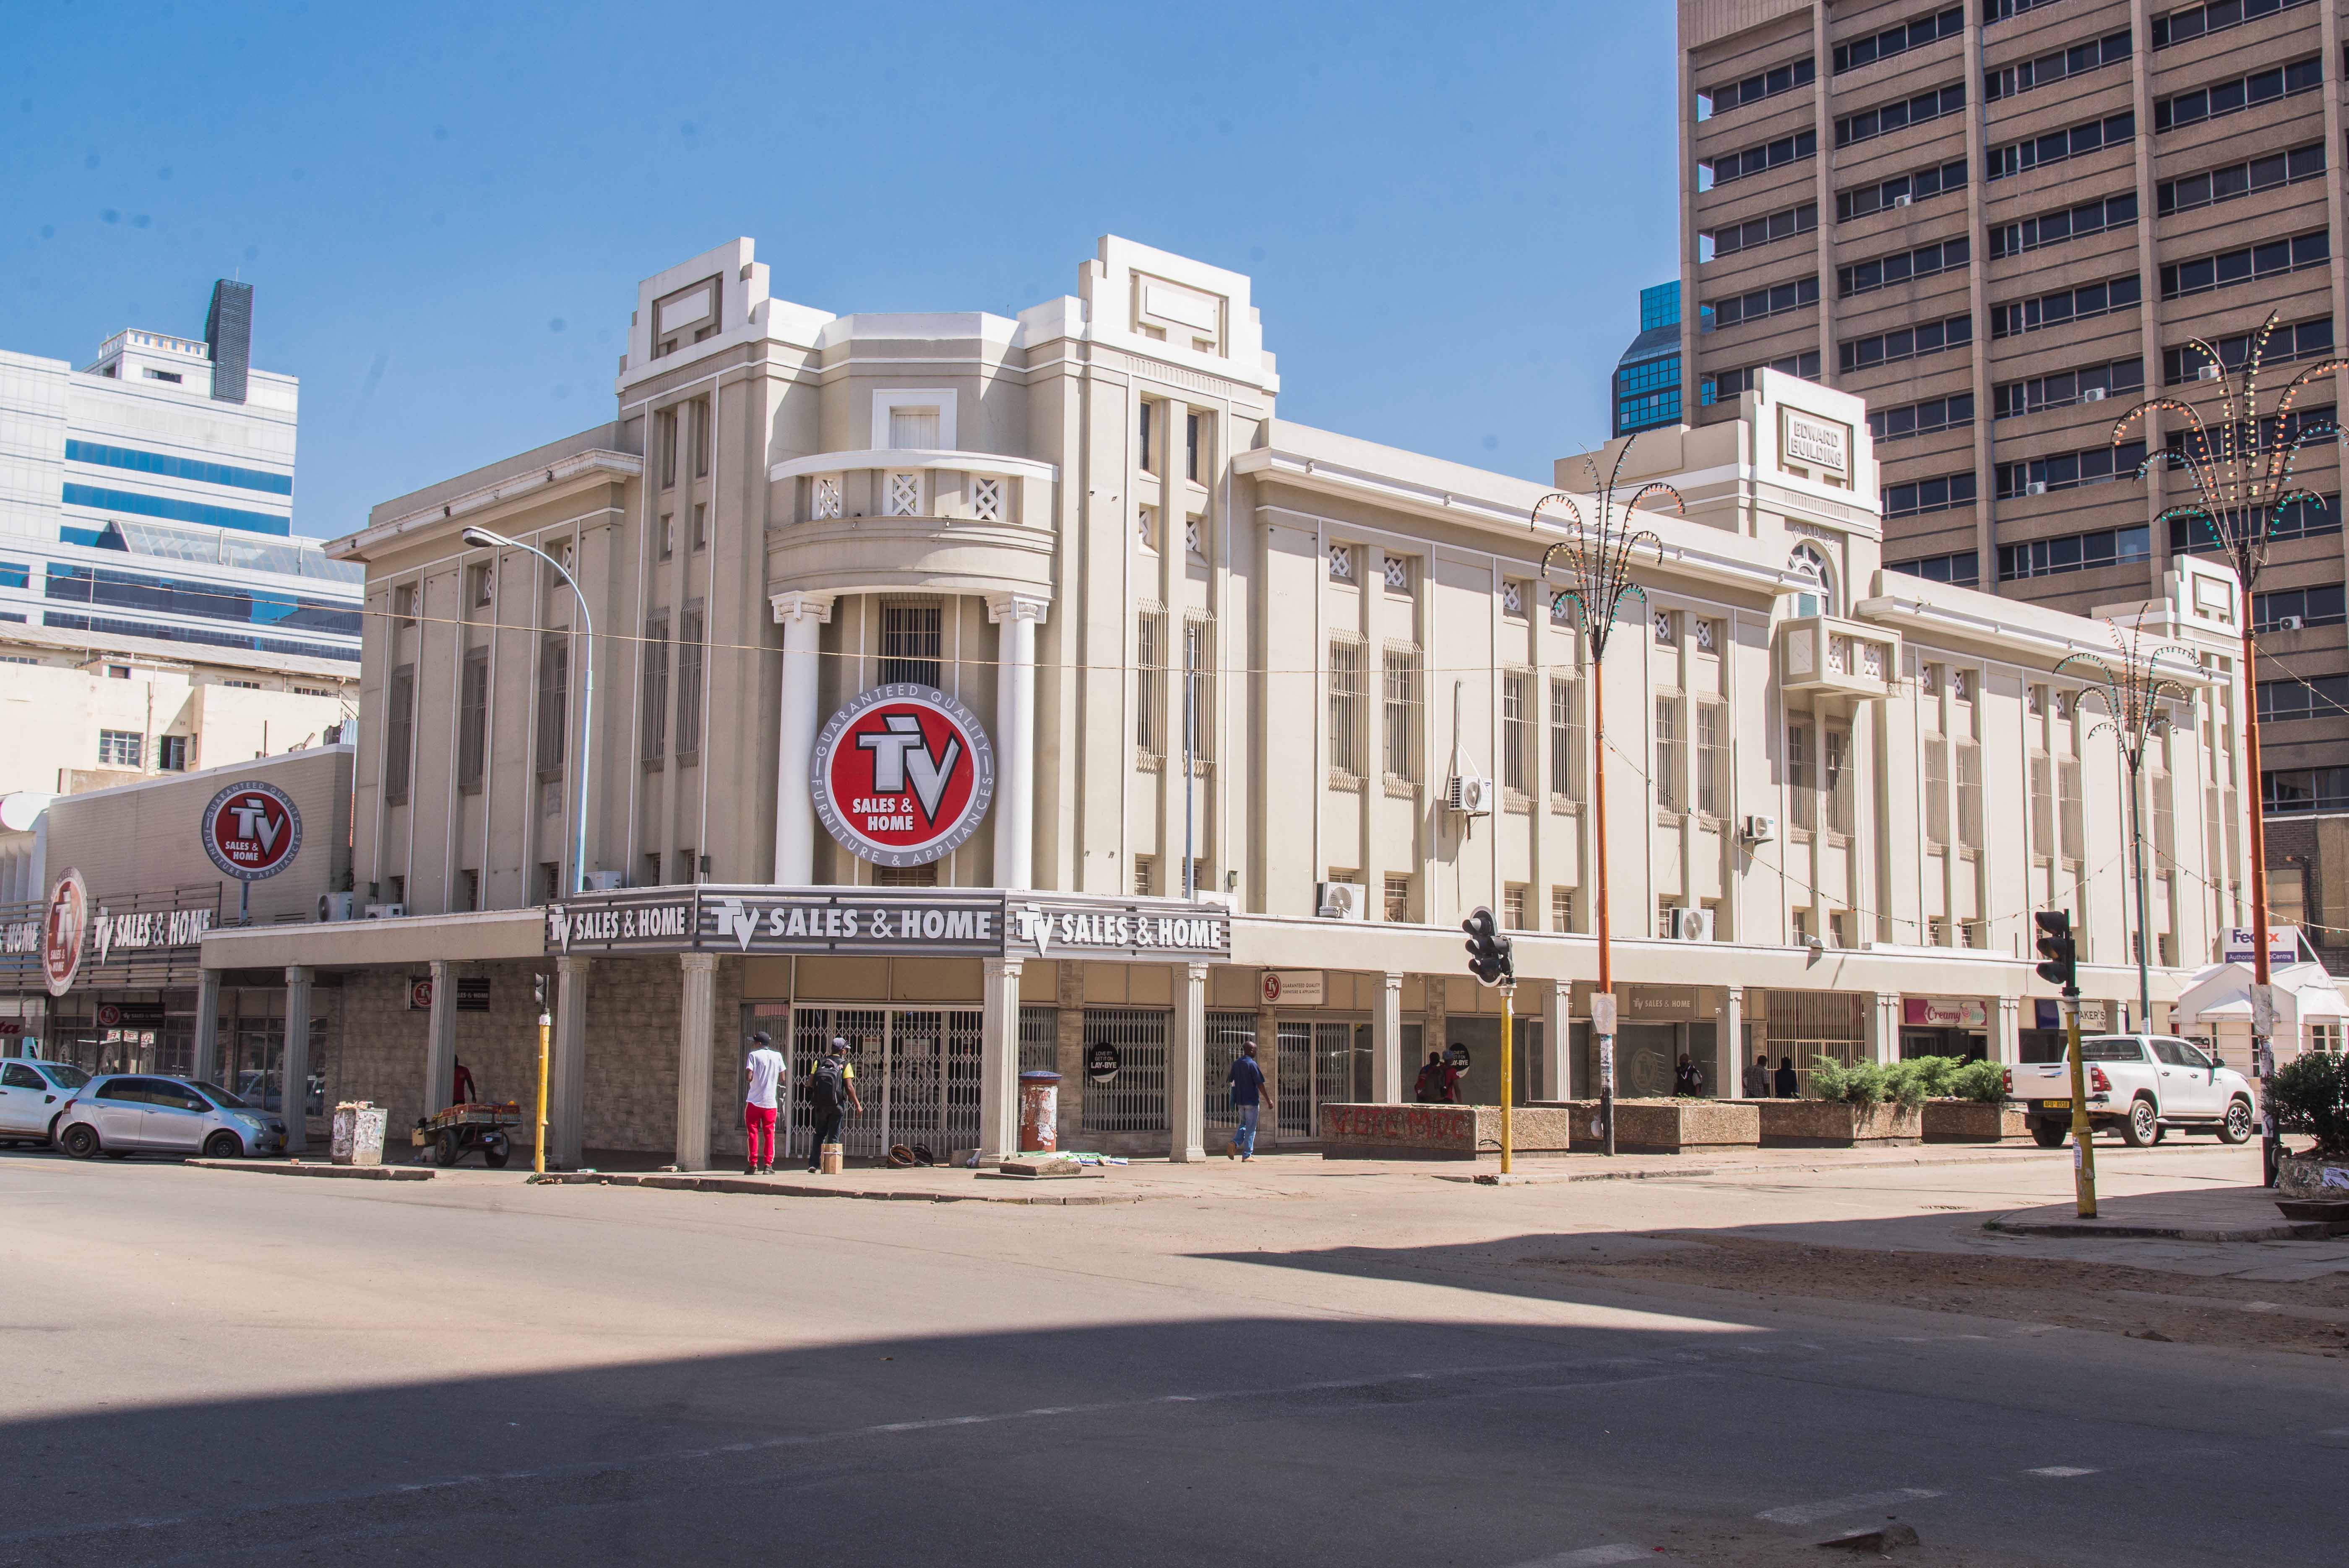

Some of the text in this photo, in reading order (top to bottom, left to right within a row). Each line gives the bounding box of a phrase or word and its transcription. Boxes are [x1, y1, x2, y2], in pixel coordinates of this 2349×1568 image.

[1794, 420, 1839, 448] EDWARD
[1791, 438, 1842, 466] BUILDING
[1806, 524, 1820, 538] AD
[816, 685, 989, 756] GUARANTEED QUALITY
[858, 716, 961, 826] TV
[207, 782, 300, 821] GUARANTEED QUALITY
[852, 798, 913, 813] SALES &
[230, 798, 285, 857] TV
[812, 777, 993, 866] FURNITURE & APPLIANCES
[867, 816, 914, 831] HOME
[204, 830, 240, 876] FURNITURE
[258, 834, 301, 878] APPLIANCES
[225, 841, 259, 851] SALES &
[233, 852, 258, 861] HOME
[55, 891, 79, 963] TV
[94, 906, 114, 967] TV
[115, 913, 152, 947] SALES
[153, 912, 164, 945] &
[549, 906, 685, 955] TV SALES & HOME
[711, 899, 992, 953] TV SALES & HOME
[1016, 901, 1221, 959] TV SALES & HOME
[1267, 978, 1278, 995] TV
[1633, 998, 1643, 1011] TV
[1927, 1006, 1961, 1024] Creamy
[2080, 1010, 2105, 1020] AKER'S
[1331, 1107, 1466, 1139] VOTE MDC
